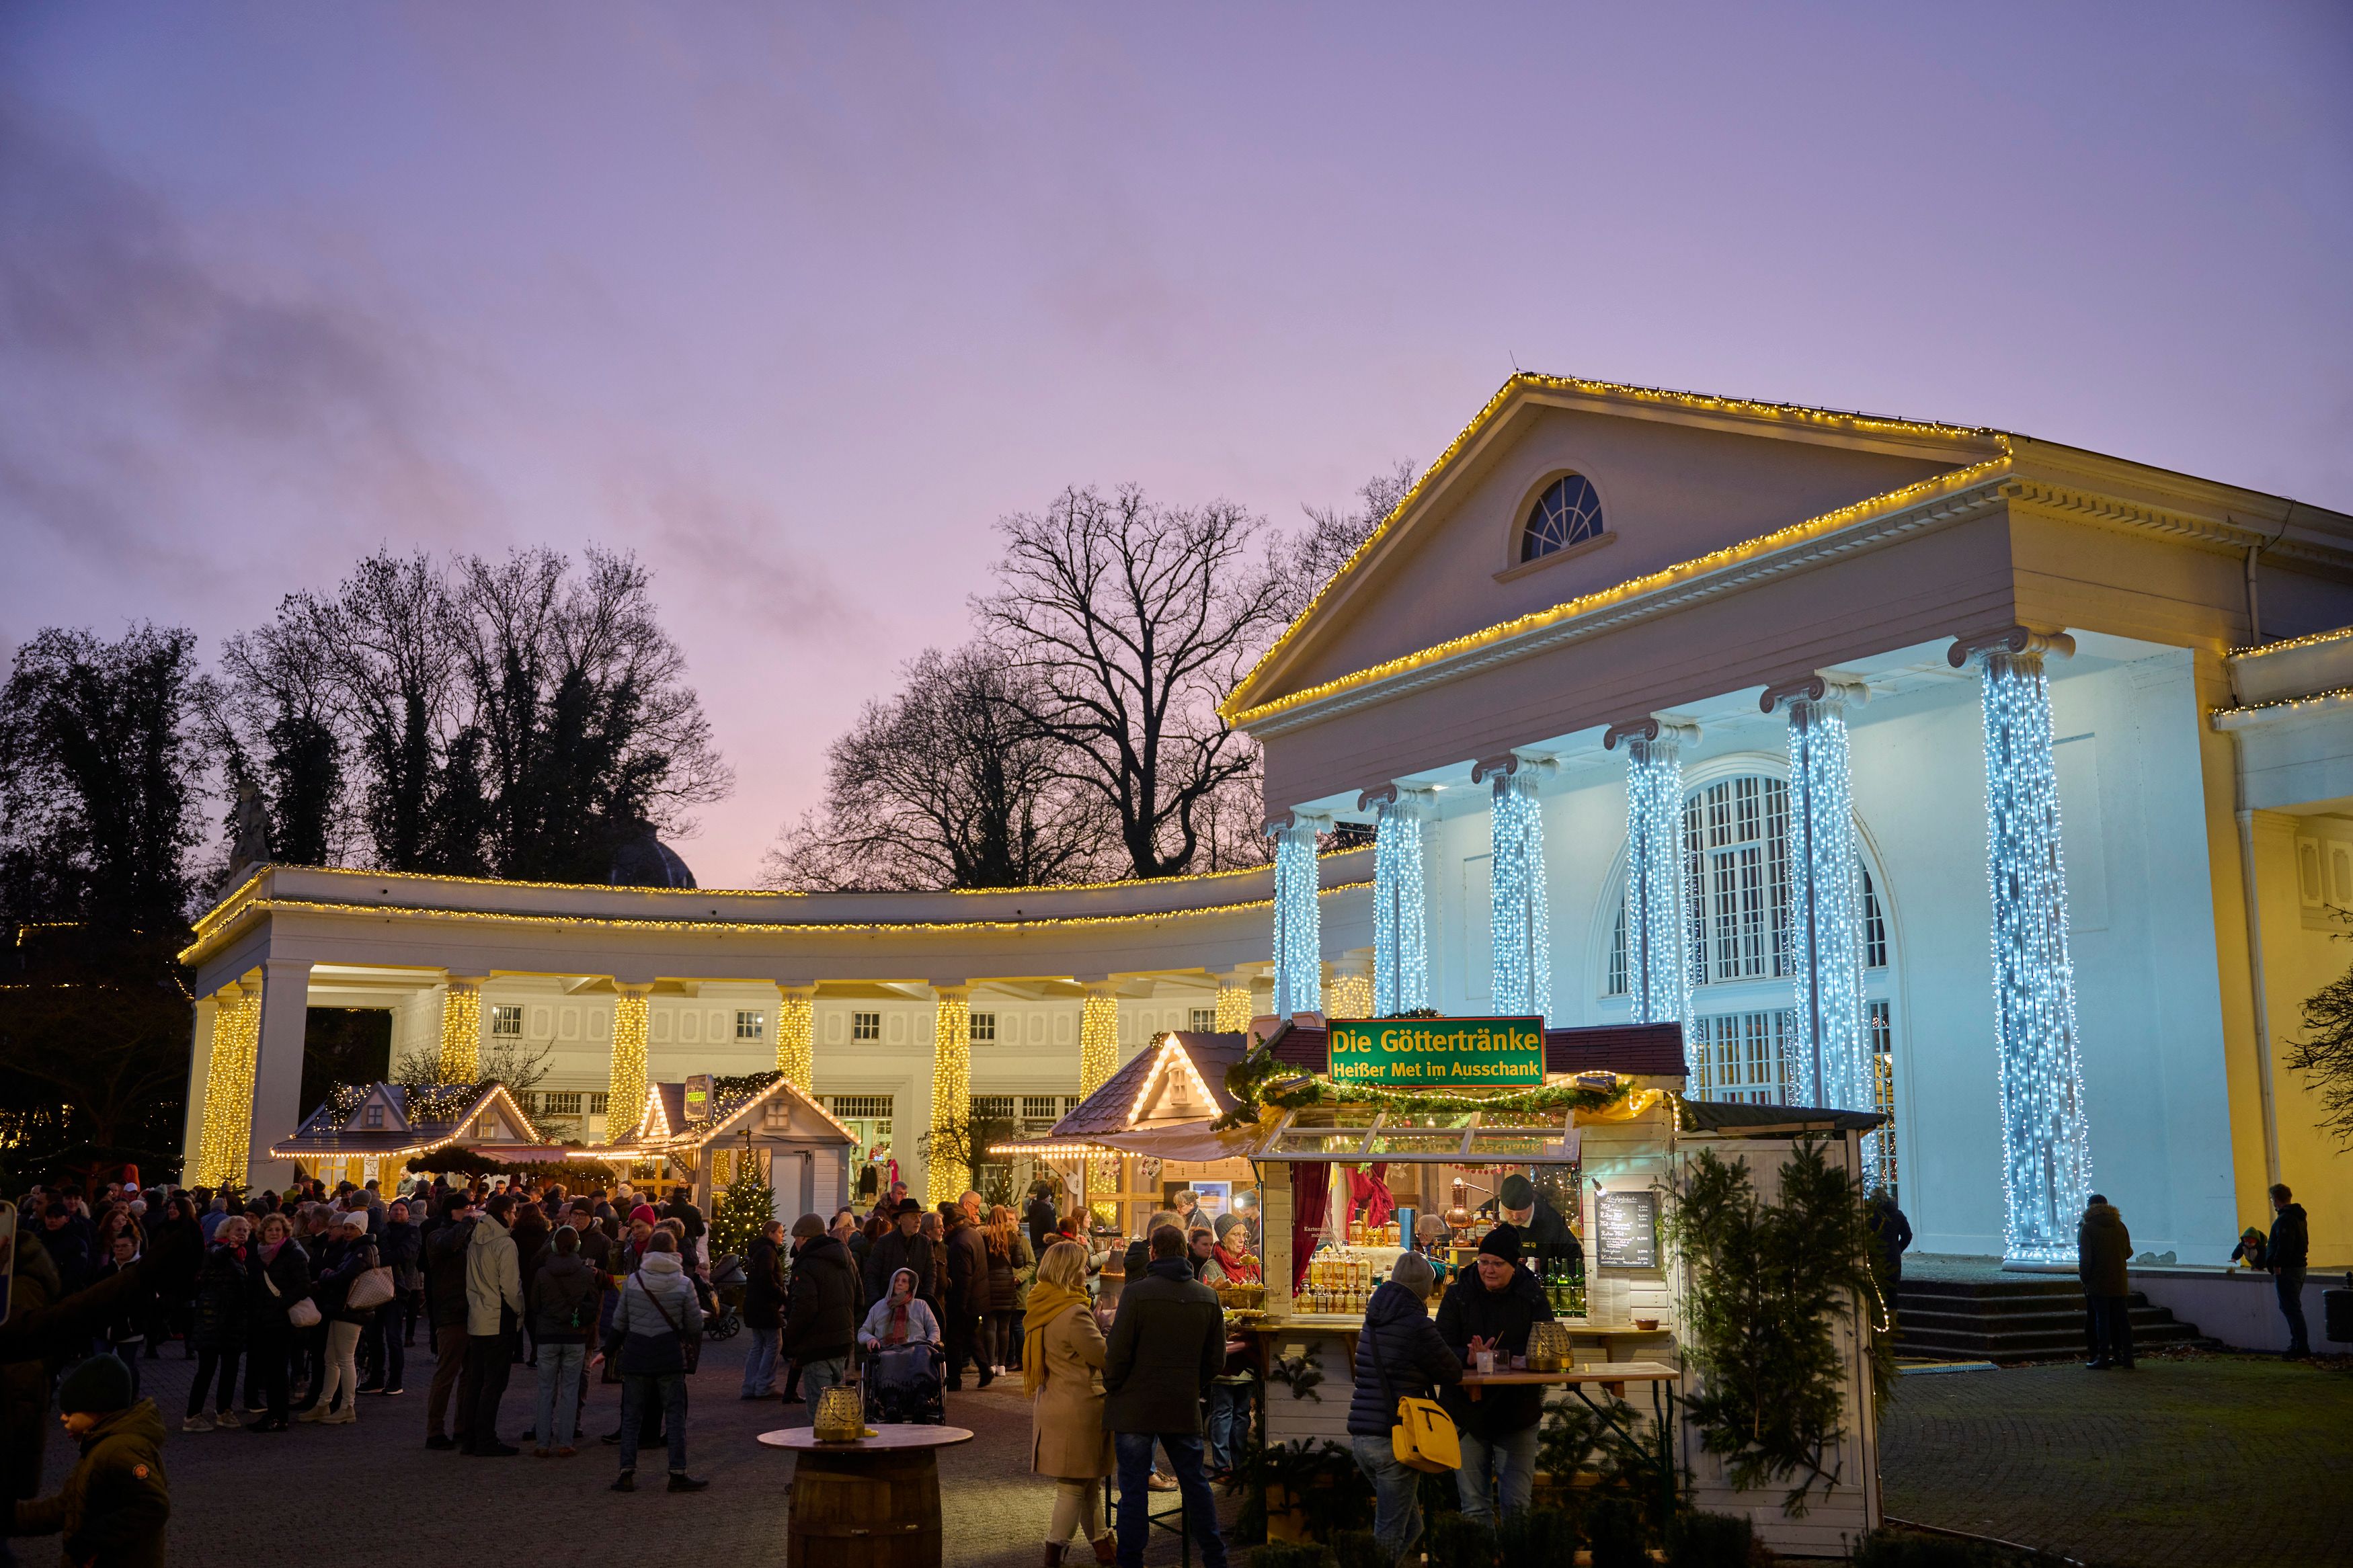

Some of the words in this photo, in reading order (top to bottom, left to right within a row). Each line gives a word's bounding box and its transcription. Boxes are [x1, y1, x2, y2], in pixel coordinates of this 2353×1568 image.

[1332, 1030, 1371, 1053] Die
[1380, 1027, 1539, 1053] Göttertränke
[1334, 1062, 1386, 1077] Heißer
[1391, 1062, 1422, 1077] Met
[1427, 1061, 1446, 1077] im
[1451, 1060, 1540, 1077] Ausschank
